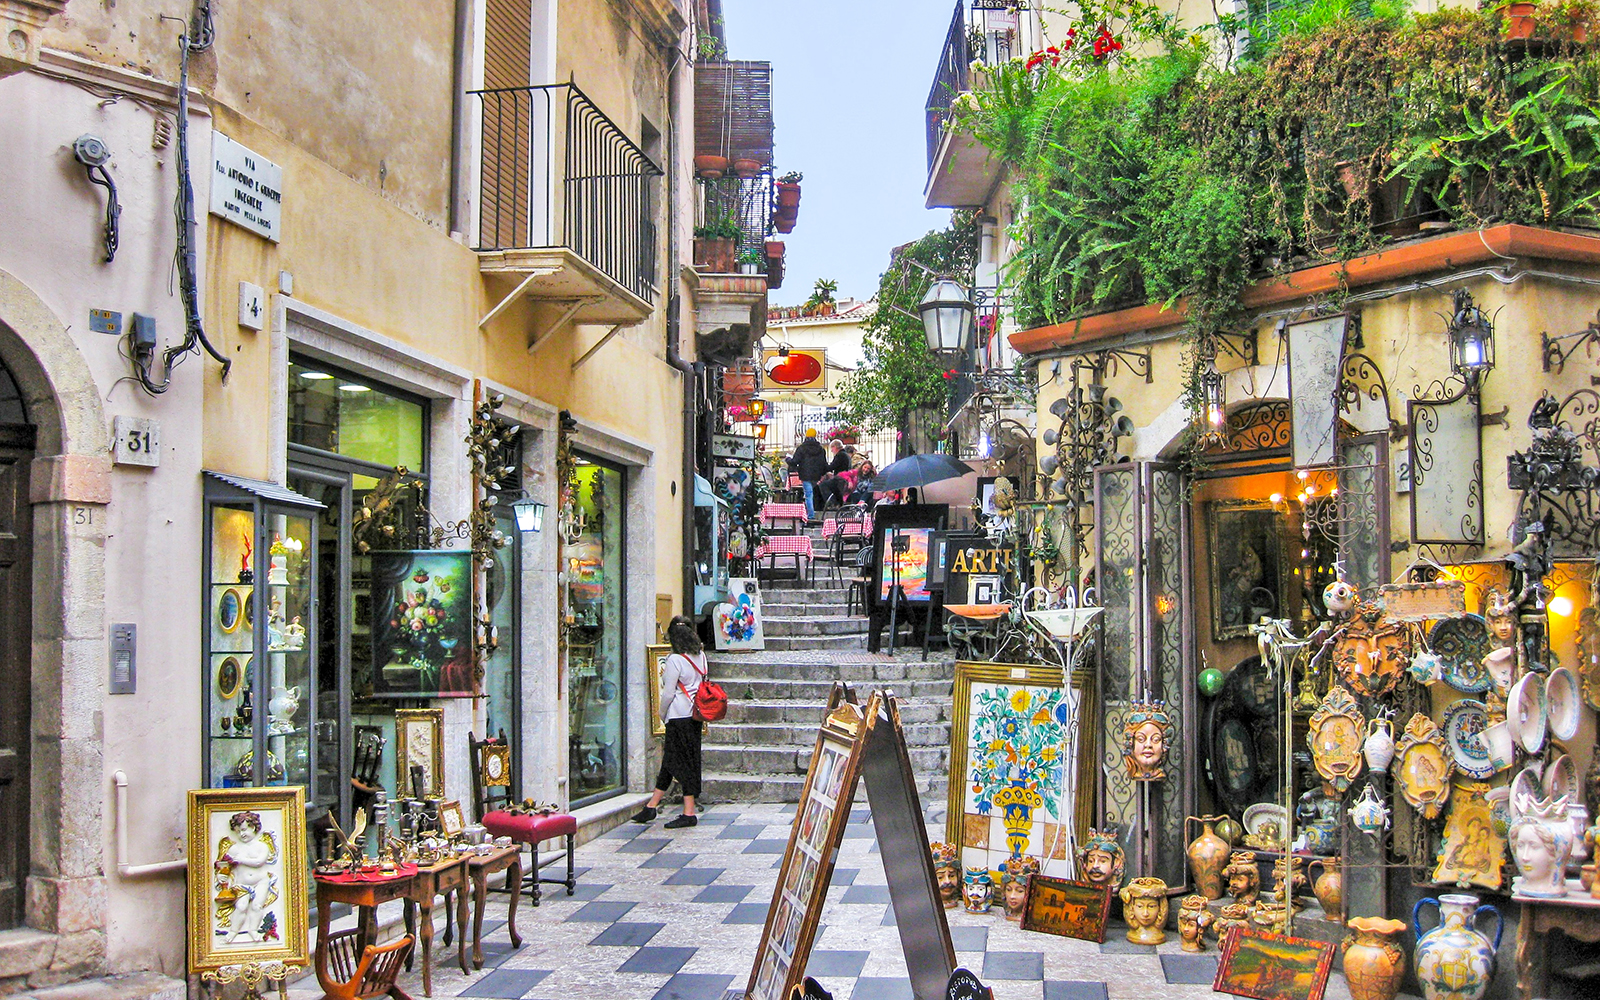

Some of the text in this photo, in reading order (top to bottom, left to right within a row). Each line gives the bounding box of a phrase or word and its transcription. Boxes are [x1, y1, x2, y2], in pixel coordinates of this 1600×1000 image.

[244, 157, 256, 171] VIA
[228, 167, 254, 188] ANTONIO
[255, 181, 259, 192] E
[260, 184, 281, 204] GIUSEPPE
[250, 297, 259, 317] 4
[128, 430, 150, 453] 31
[75, 507, 92, 525] 31
